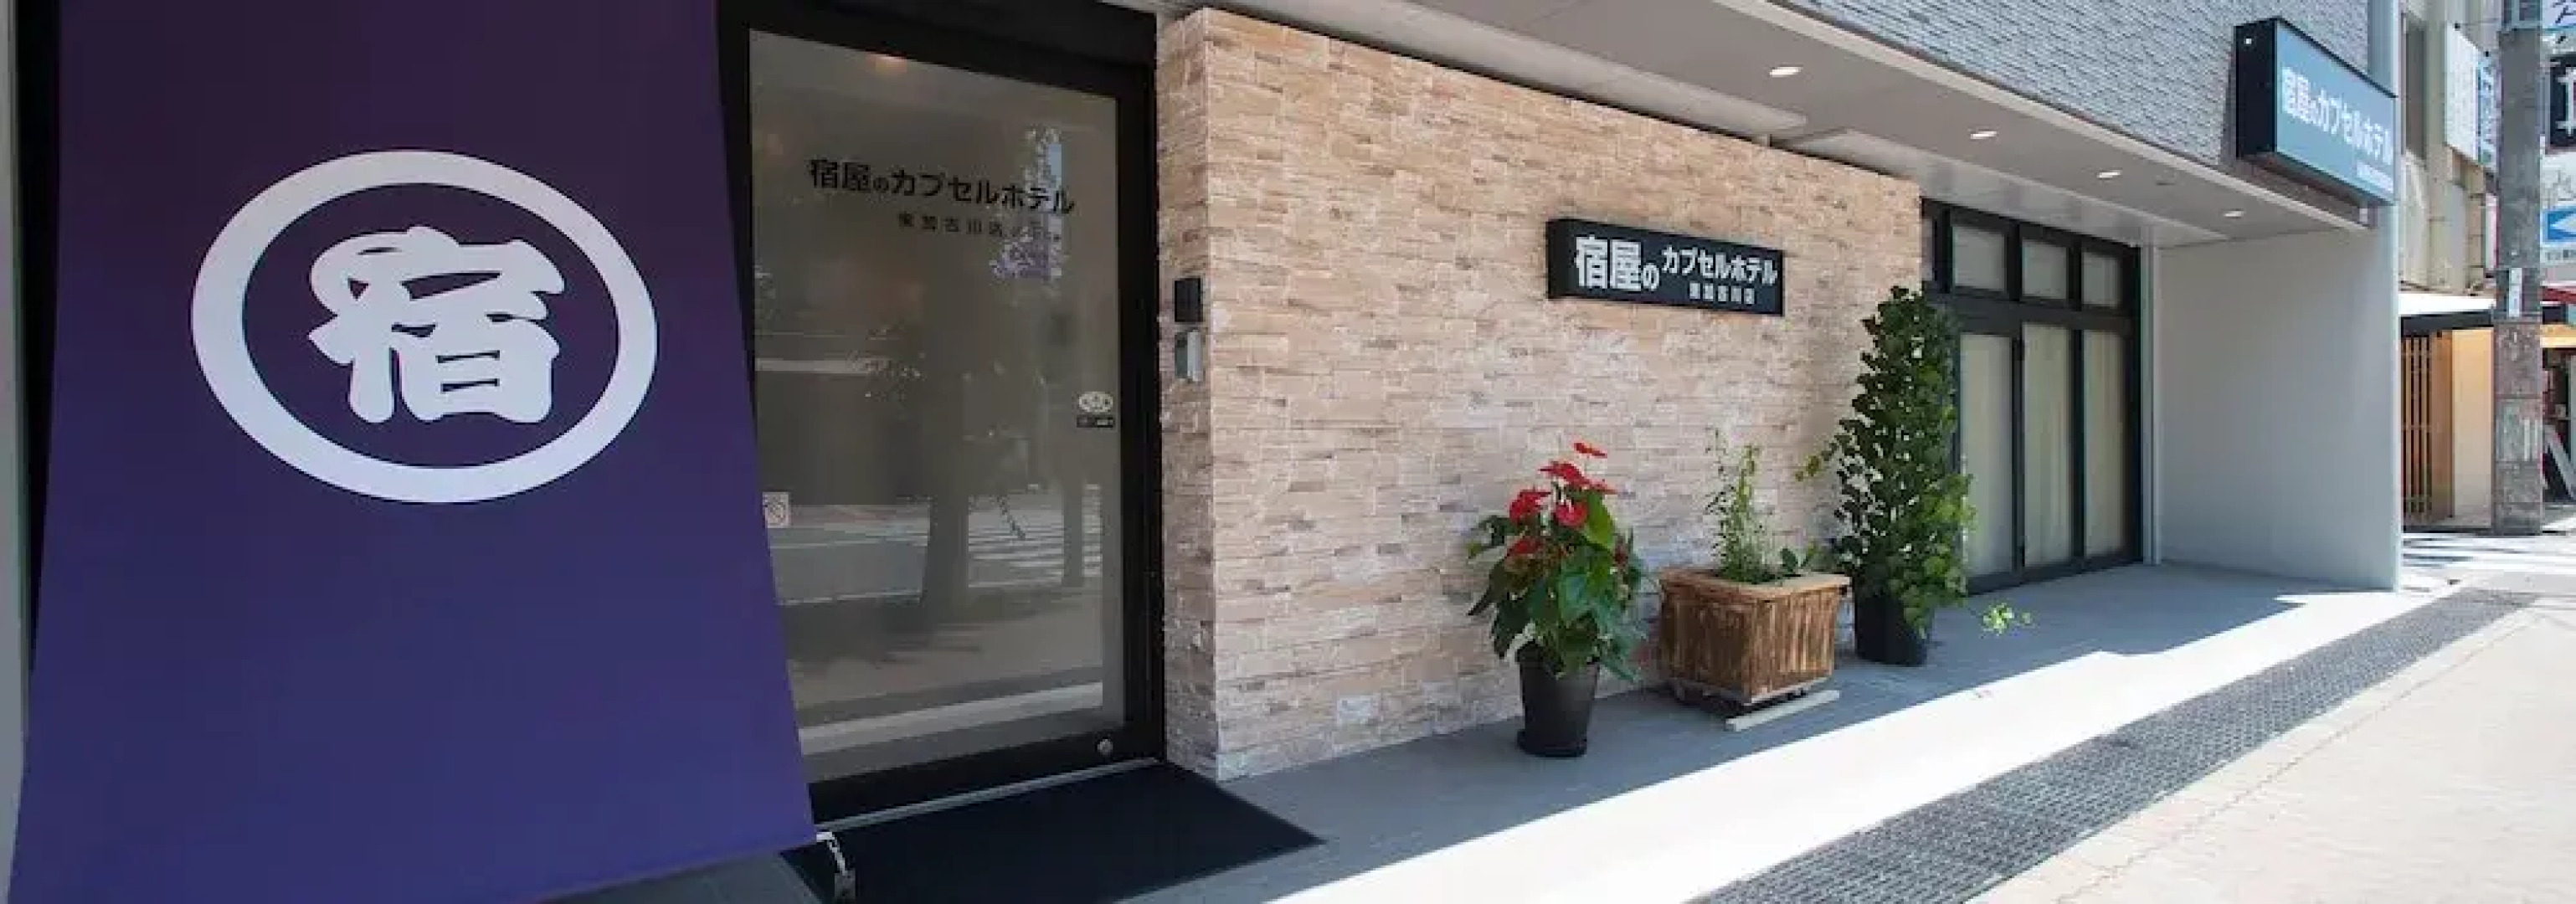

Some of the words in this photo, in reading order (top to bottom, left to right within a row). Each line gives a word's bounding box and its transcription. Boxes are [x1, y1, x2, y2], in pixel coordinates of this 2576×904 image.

[809, 159, 1076, 214] 宿屋のカプセルホテル
[307, 225, 566, 424] 宿
